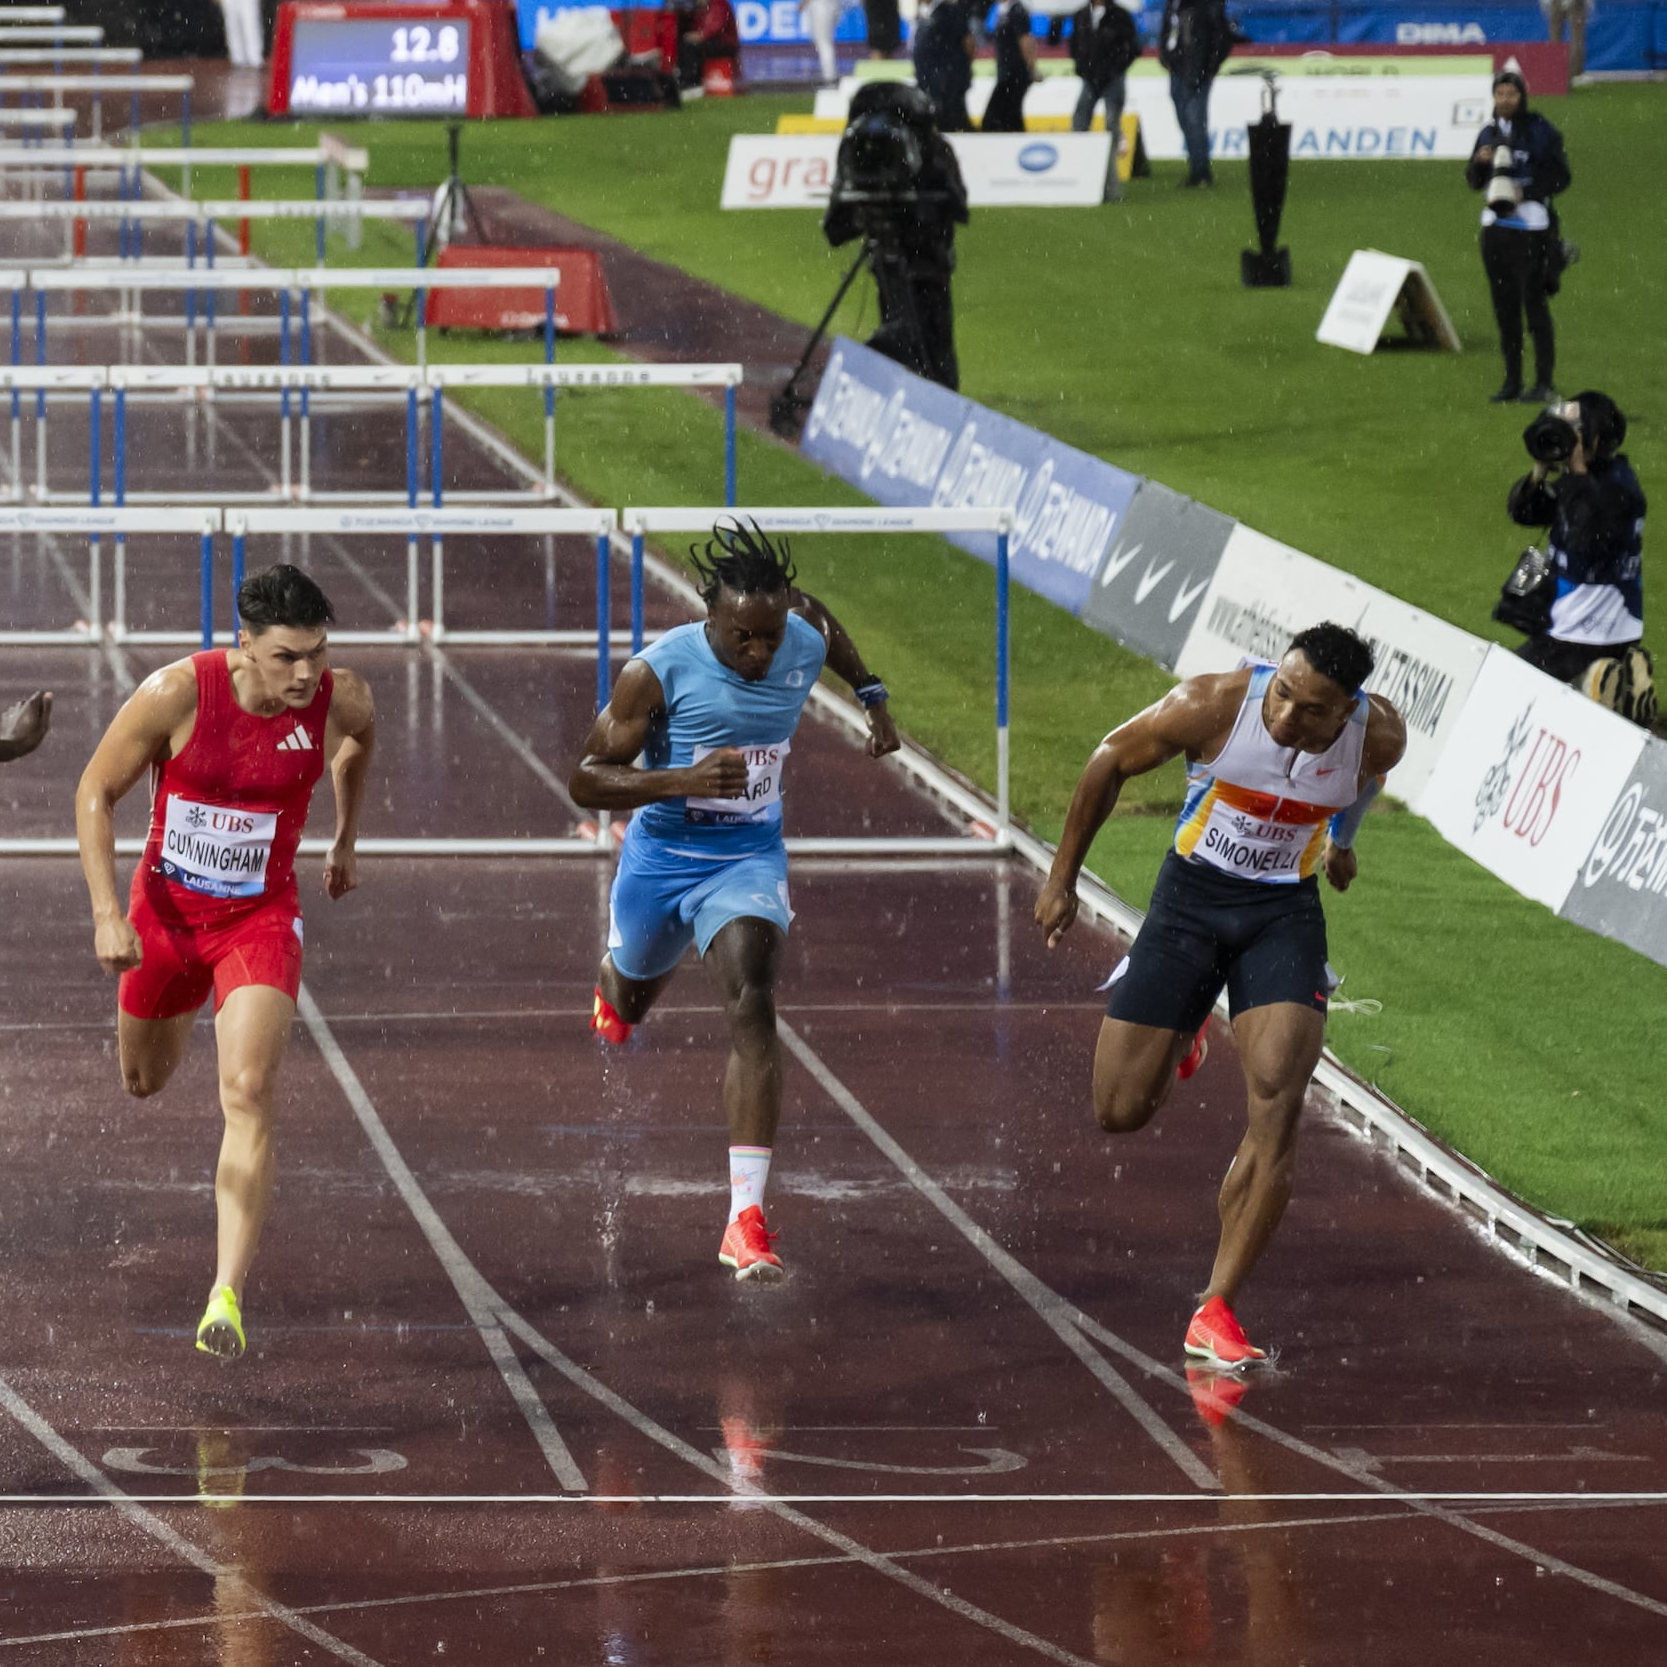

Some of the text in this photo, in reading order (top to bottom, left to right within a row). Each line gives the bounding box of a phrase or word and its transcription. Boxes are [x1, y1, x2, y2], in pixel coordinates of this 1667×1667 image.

[390, 26, 459, 63] 12.8
[1397, 22, 1486, 45] DIMA
[290, 73, 467, 108] Men's 110mH
[1503, 727, 1581, 847] UBS
[211, 812, 254, 834] UBS
[1255, 824, 1298, 842] UBS
[167, 829, 265, 873] CUNNINGHAM
[1204, 827, 1301, 871] SIMONELLI
[183, 873, 242, 895] LAUSANNE
